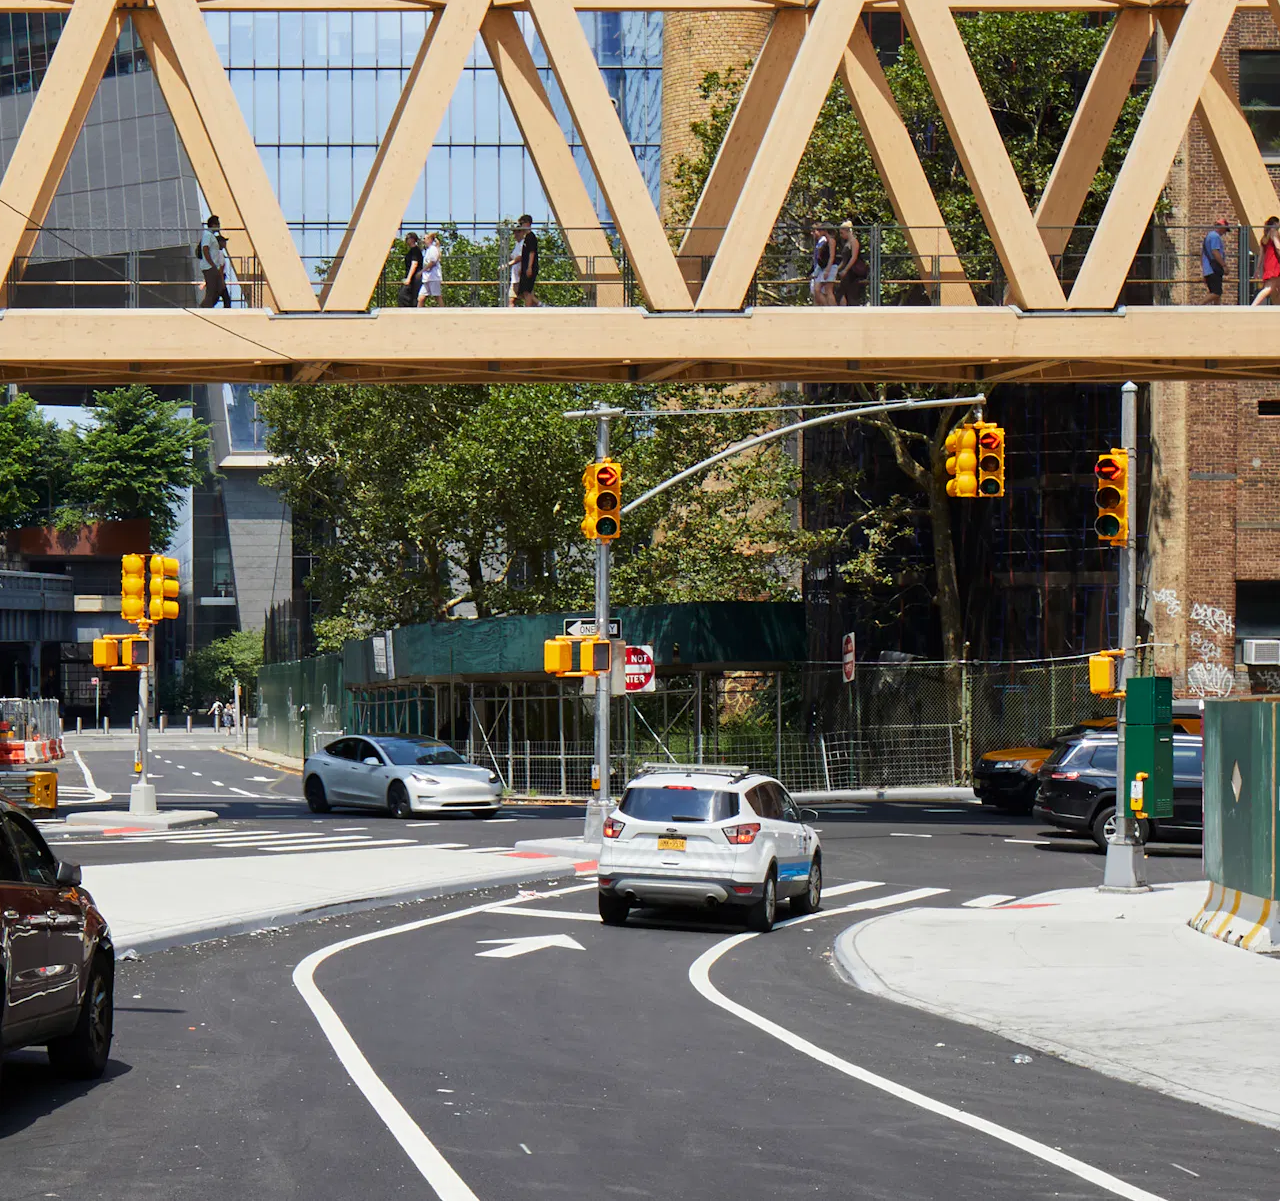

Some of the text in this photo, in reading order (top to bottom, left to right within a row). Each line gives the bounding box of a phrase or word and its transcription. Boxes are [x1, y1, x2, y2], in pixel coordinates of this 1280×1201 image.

[580, 625, 596, 633] ONE
[631, 655, 648, 663] NOT
[625, 675, 645, 683] NTER
